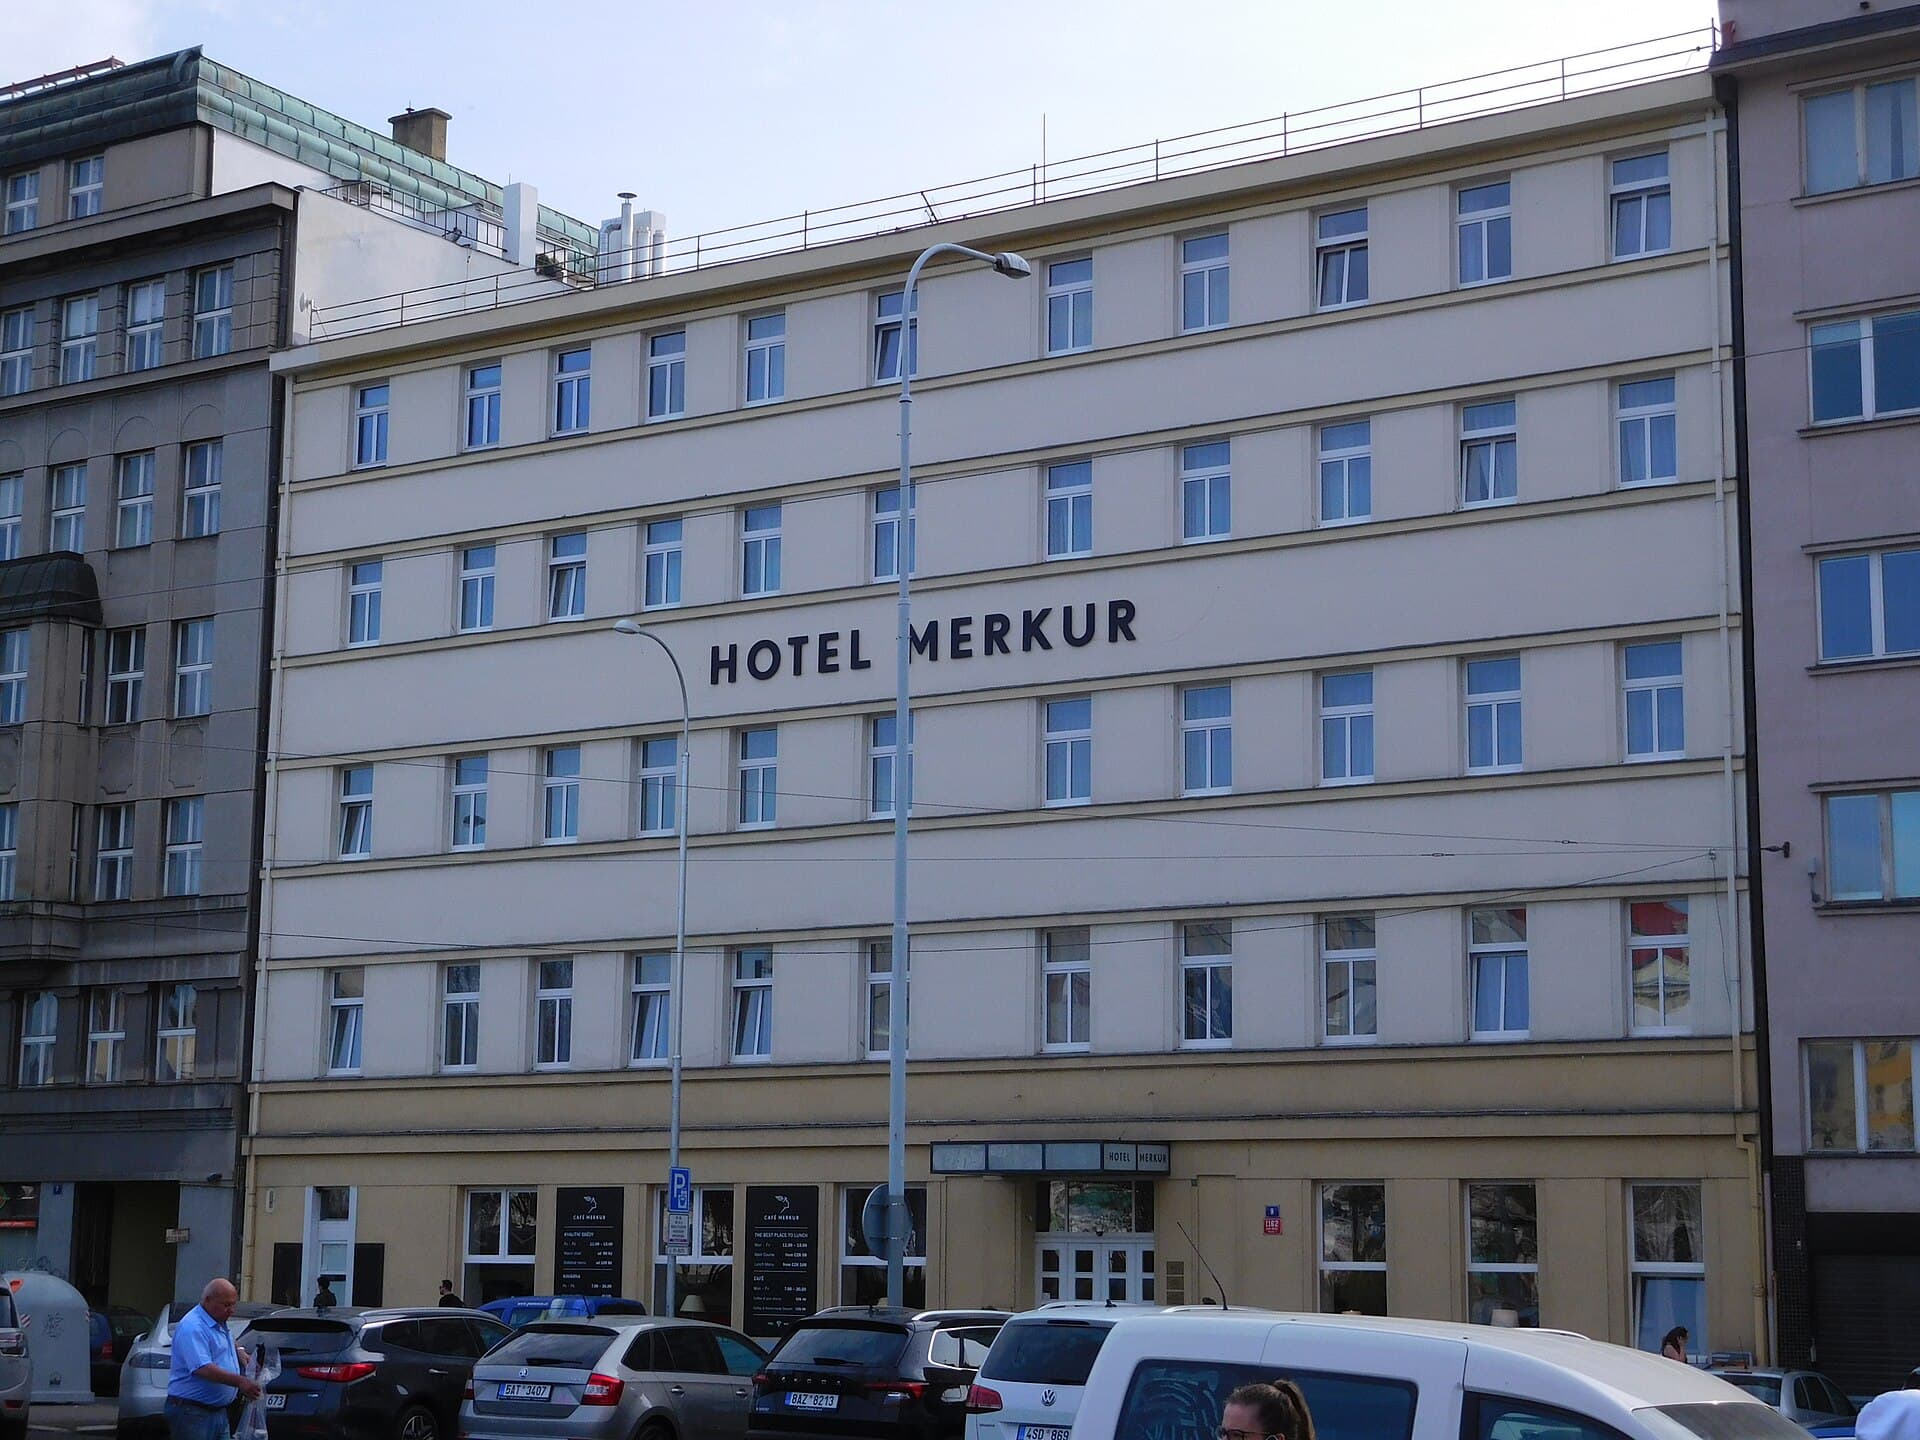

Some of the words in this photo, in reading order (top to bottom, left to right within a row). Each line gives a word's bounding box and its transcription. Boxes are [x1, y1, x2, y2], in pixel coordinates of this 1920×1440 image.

[710, 629, 871, 685] HOTEL
[908, 599, 1137, 664] MERKUR
[1109, 1151, 1131, 1162] HOTEL
[1139, 1152, 1167, 1163] MERKUR
[673, 1172, 686, 1198] P
[525, 1385, 547, 1397] 3407
[791, 1393, 808, 1405] 8AZ
[813, 1394, 834, 1407] 8213
[1026, 1427, 1044, 1440] 4SD
